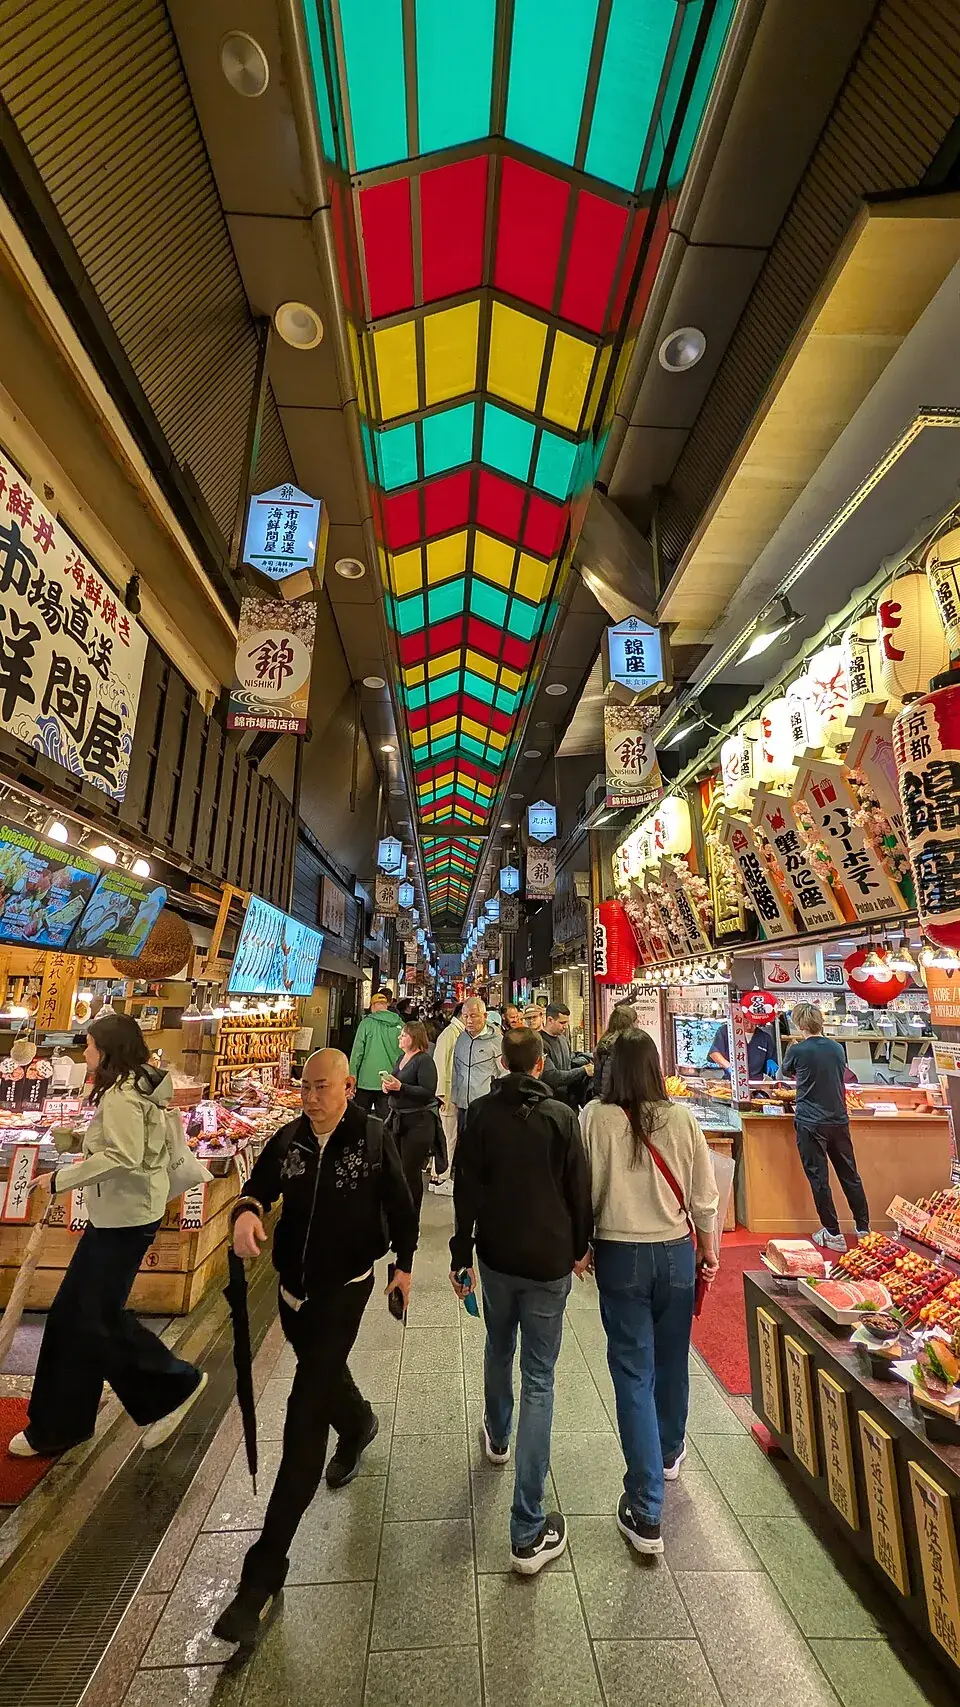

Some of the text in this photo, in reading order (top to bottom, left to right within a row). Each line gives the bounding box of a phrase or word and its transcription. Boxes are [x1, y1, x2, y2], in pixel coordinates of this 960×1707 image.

[264, 507, 283, 552] 海鮮問屋
[281, 509, 299, 554] 市場直送
[0, 519, 115, 681] 市場直送
[64, 550, 131, 647] 海鮮焼き
[247, 638, 294, 691] 錦
[624, 639, 645, 672] 錦座
[849, 656, 867, 694] 錦座
[244, 679, 275, 689] NISHIKI
[234, 716, 299, 731] 錦市場商店街
[907, 709, 931, 762] 京都
[614, 736, 648, 776] 錦
[612, 790, 658, 805] 錦市場商店街
[0, 825, 39, 852] Specialty
[37, 841, 69, 863] Tempura
[822, 807, 880, 895] ハリーポテト
[379, 887, 393, 904] 錦
[531, 862, 549, 884] 錦
[855, 901, 874, 914] Potato
[878, 896, 896, 909] Drink
[41, 953, 64, 1027] 溢れる肉汁
[932, 987, 950, 1001] KOBE
[826, 1407, 843, 1481] 神戸牛
[869, 1454, 891, 1540] 近江牛
[877, 1545, 897, 1581] BEEF
[922, 1510, 949, 1612] 佐賀牛
[931, 1596, 956, 1642] SAGA
[934, 1614, 959, 1661] BEEF
